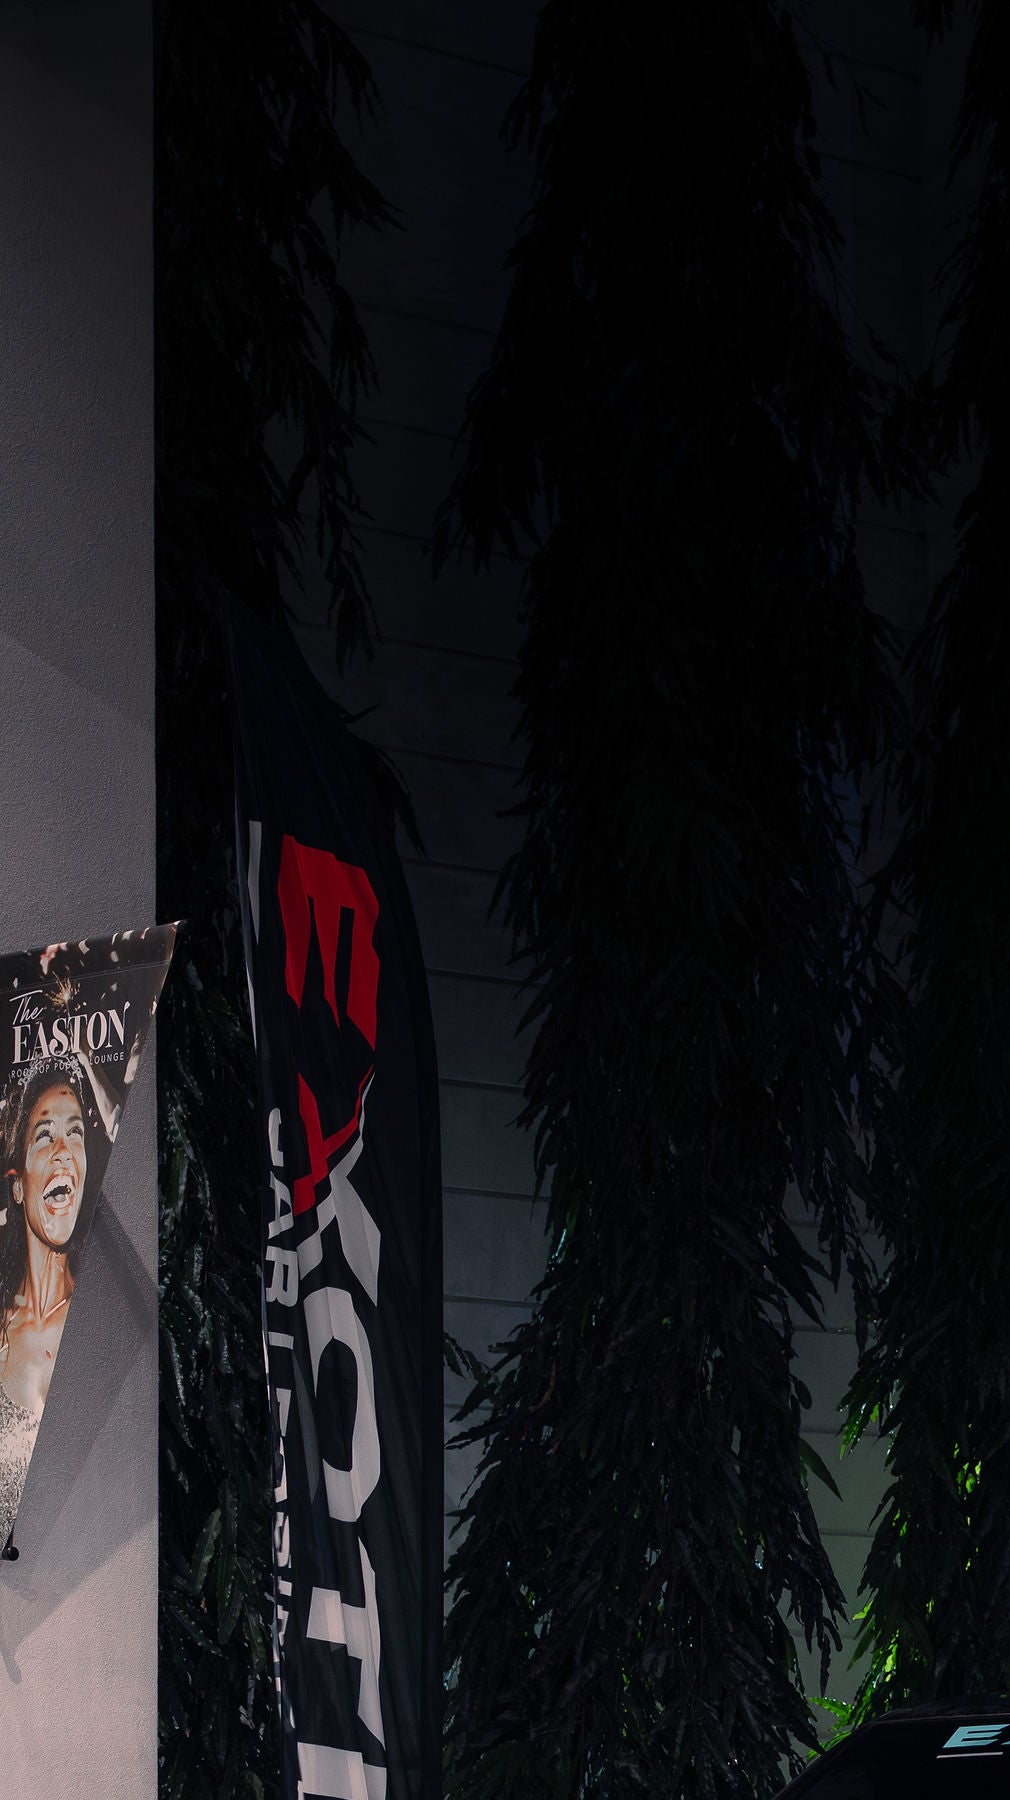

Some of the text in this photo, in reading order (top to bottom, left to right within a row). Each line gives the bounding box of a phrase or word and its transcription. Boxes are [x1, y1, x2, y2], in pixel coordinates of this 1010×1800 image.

[9, 989, 44, 1026] The
[12, 1000, 130, 1065] EASTON
[11, 1063, 49, 1080] ROOOP
[88, 1051, 125, 1067] LOUNGE
